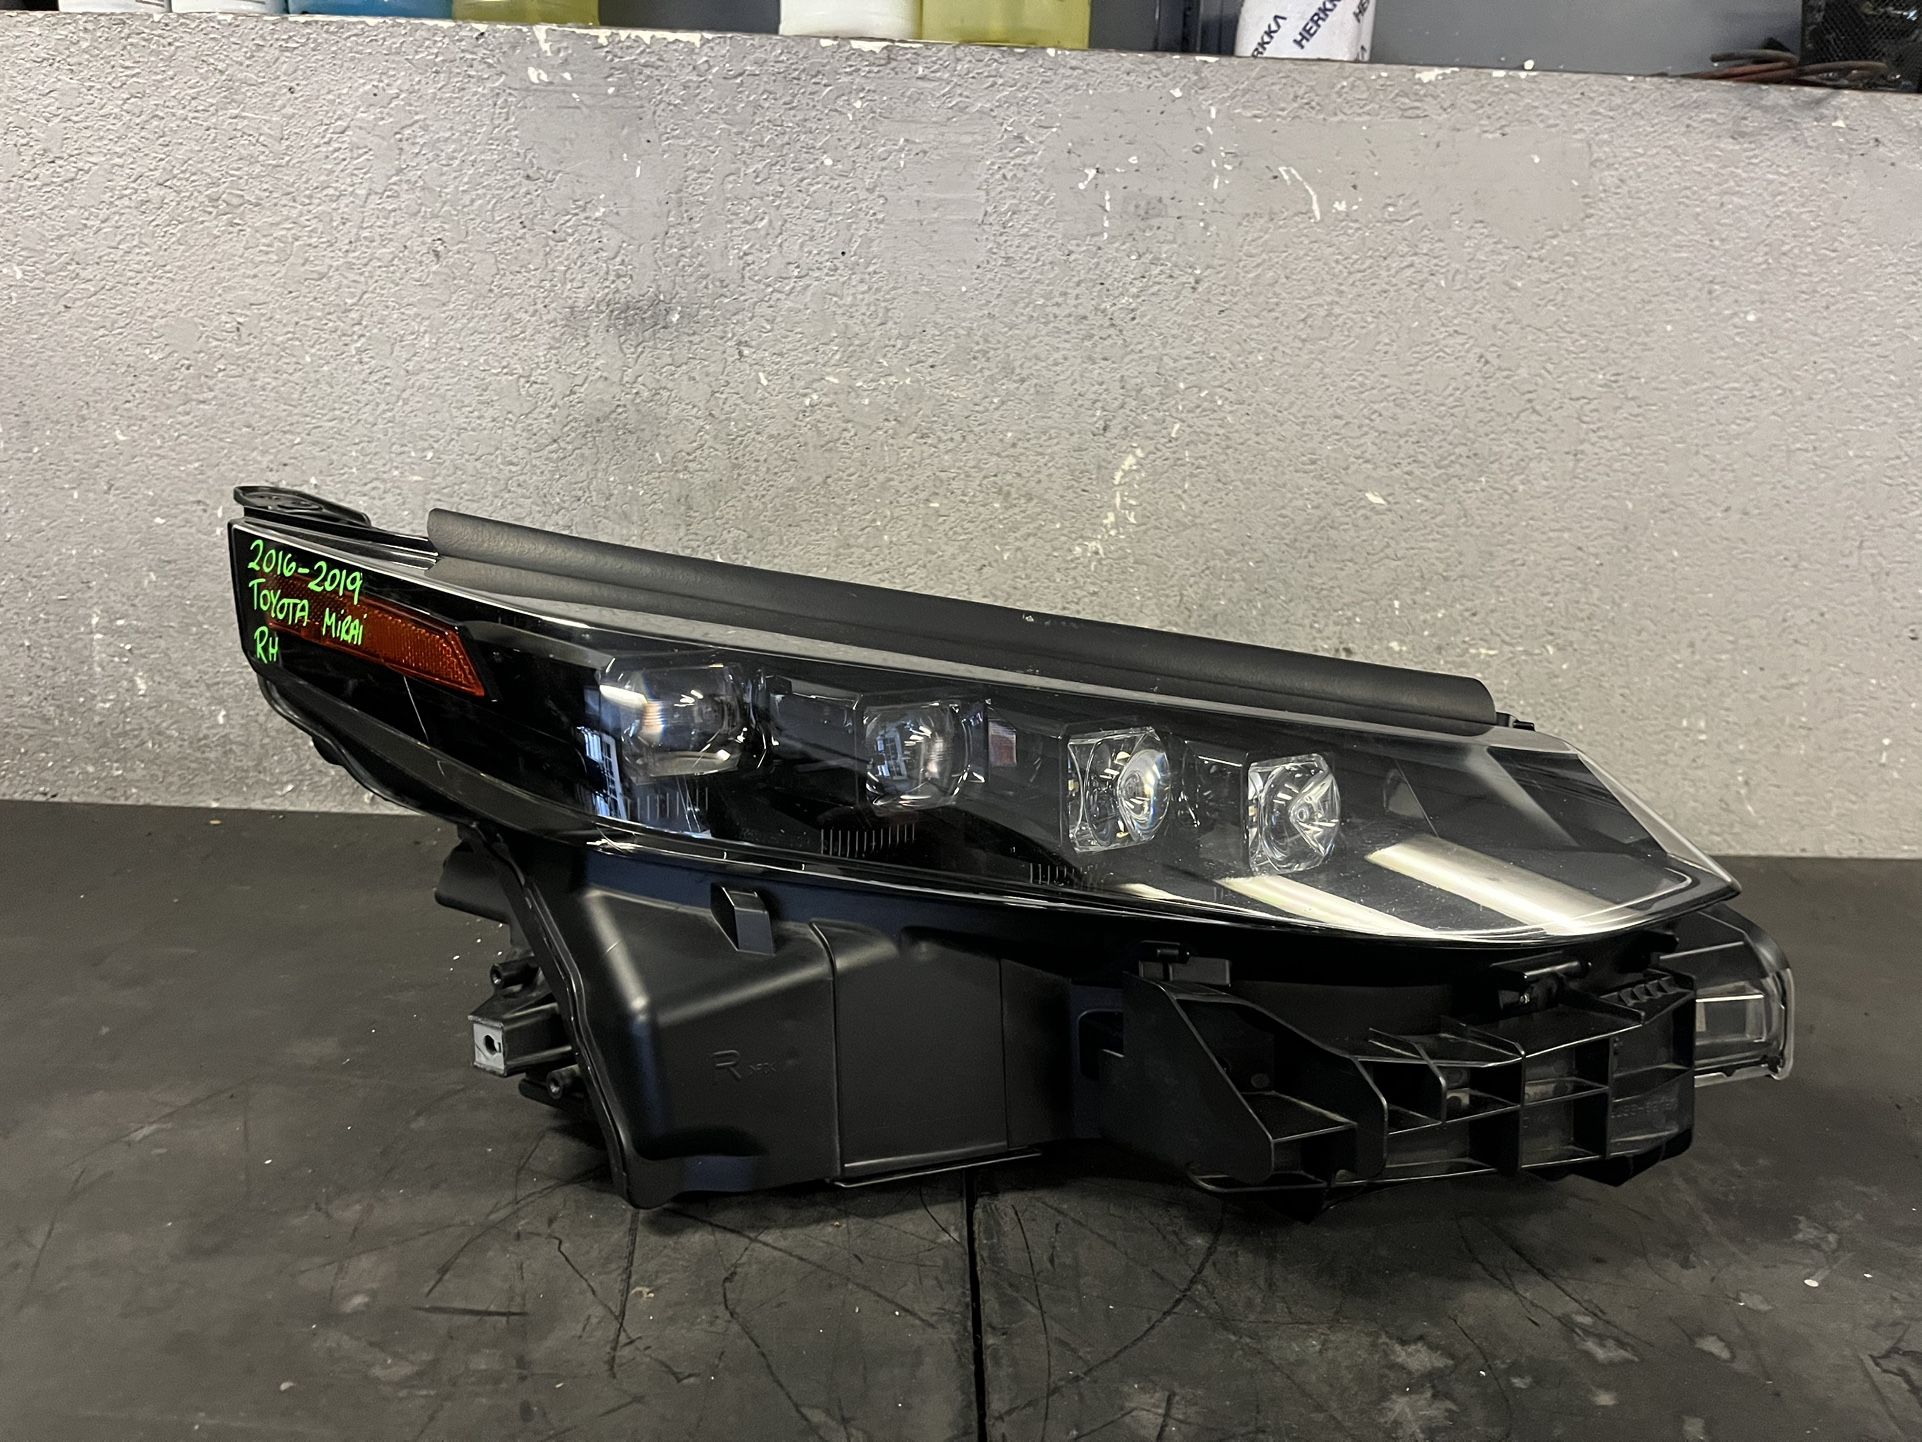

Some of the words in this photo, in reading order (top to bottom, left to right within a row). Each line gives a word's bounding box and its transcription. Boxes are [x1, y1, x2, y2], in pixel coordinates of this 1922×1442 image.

[247, 539, 363, 605] 2016-2019
[248, 578, 310, 627] TOYOTA
[253, 625, 279, 664] RH
